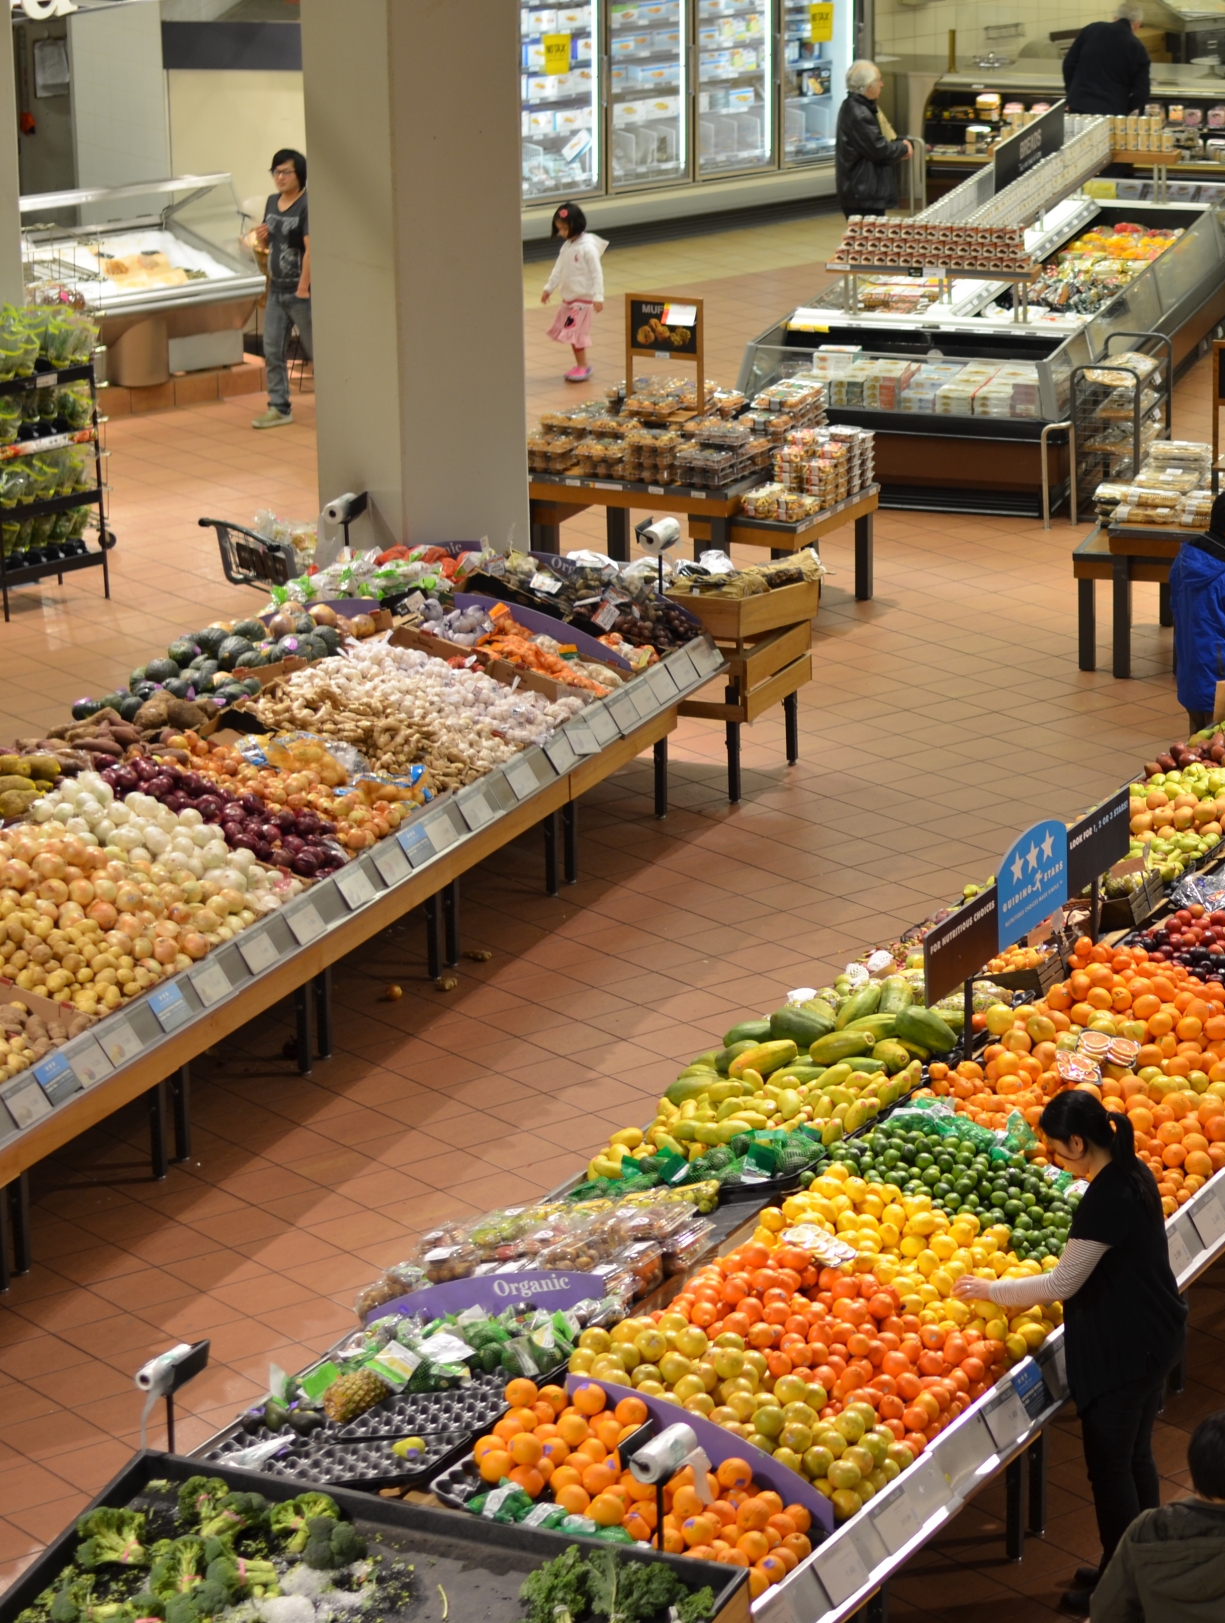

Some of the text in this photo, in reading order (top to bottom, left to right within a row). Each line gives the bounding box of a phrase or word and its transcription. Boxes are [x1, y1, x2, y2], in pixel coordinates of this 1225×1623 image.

[1069, 833, 1083, 850] LOOK
[1083, 826, 1093, 840] FOR
[1102, 814, 1109, 826] OR
[1113, 799, 1129, 817] STARS!
[1002, 860, 1064, 913] GUIDING STARS
[930, 899, 996, 955] FOR NUTRITIOUS CHOICES
[493, 1273, 571, 1298] Organic
